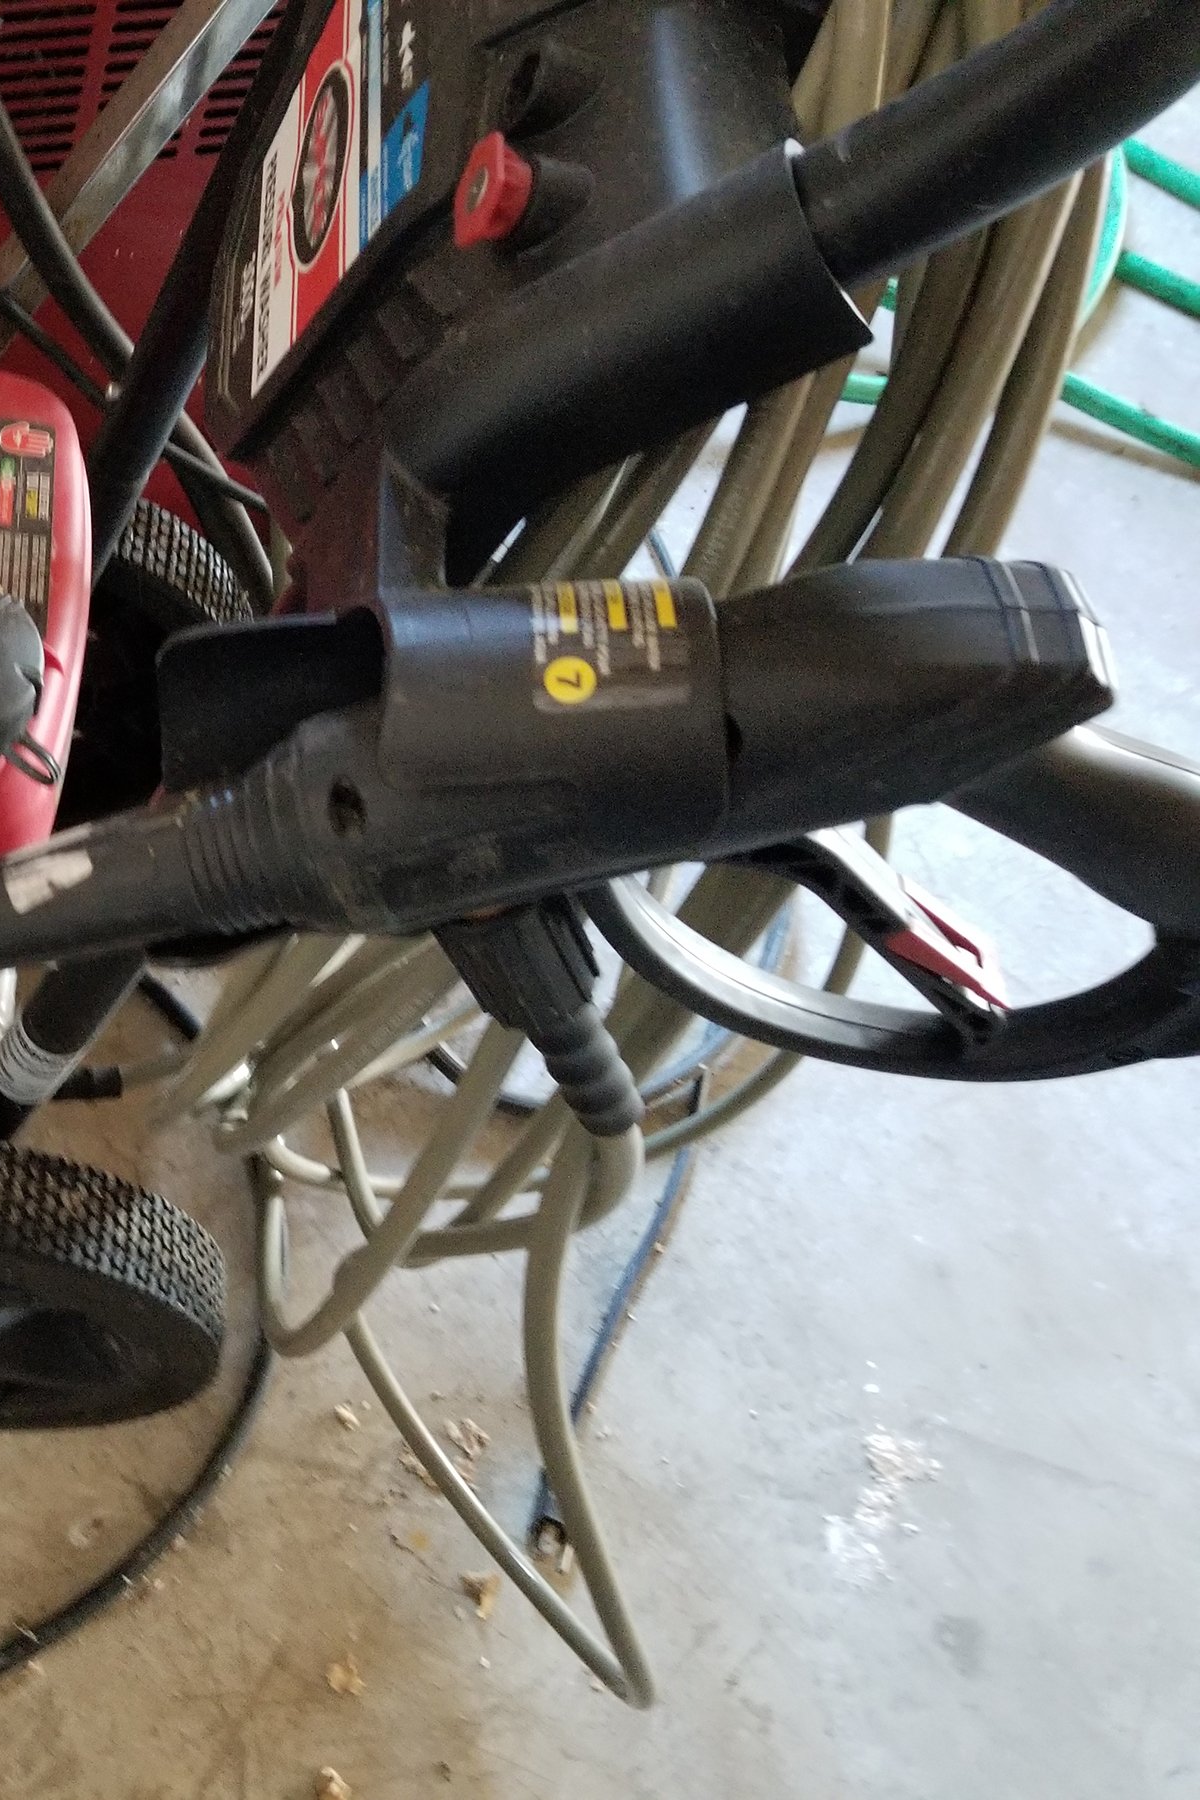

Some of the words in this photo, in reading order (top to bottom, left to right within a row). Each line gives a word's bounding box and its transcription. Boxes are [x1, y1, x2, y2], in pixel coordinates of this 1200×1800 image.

[262, 150, 277, 267] PRESSURE
[257, 263, 271, 378] WASHER
[556, 672, 581, 690] 7
